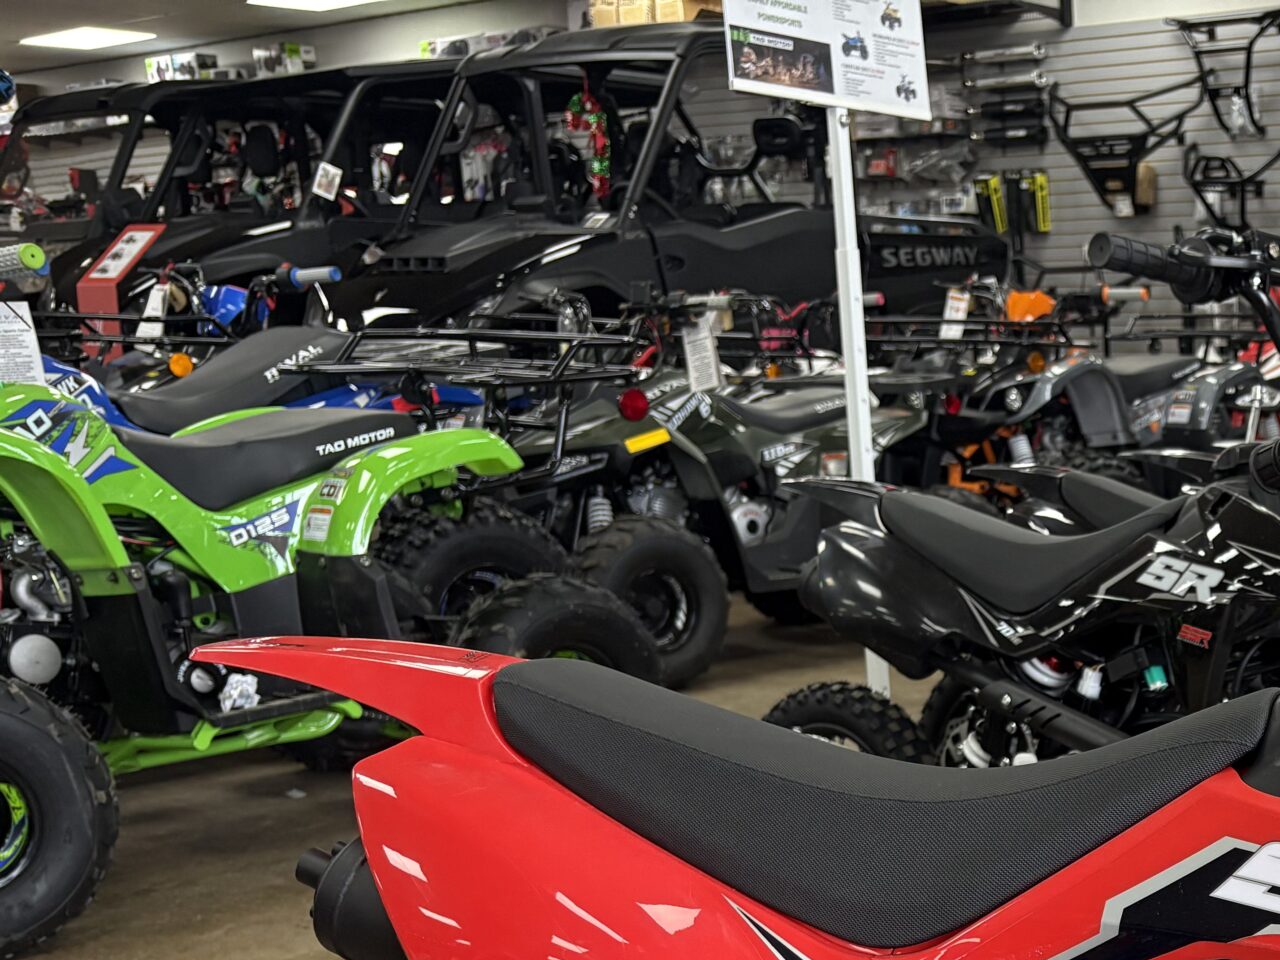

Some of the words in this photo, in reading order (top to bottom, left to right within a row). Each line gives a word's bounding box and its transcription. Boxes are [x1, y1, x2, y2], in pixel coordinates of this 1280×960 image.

[881, 247, 978, 269] SEGWAY
[316, 440, 346, 456] TAO
[347, 427, 396, 448] MOTOR
[1136, 554, 1225, 605] SR
